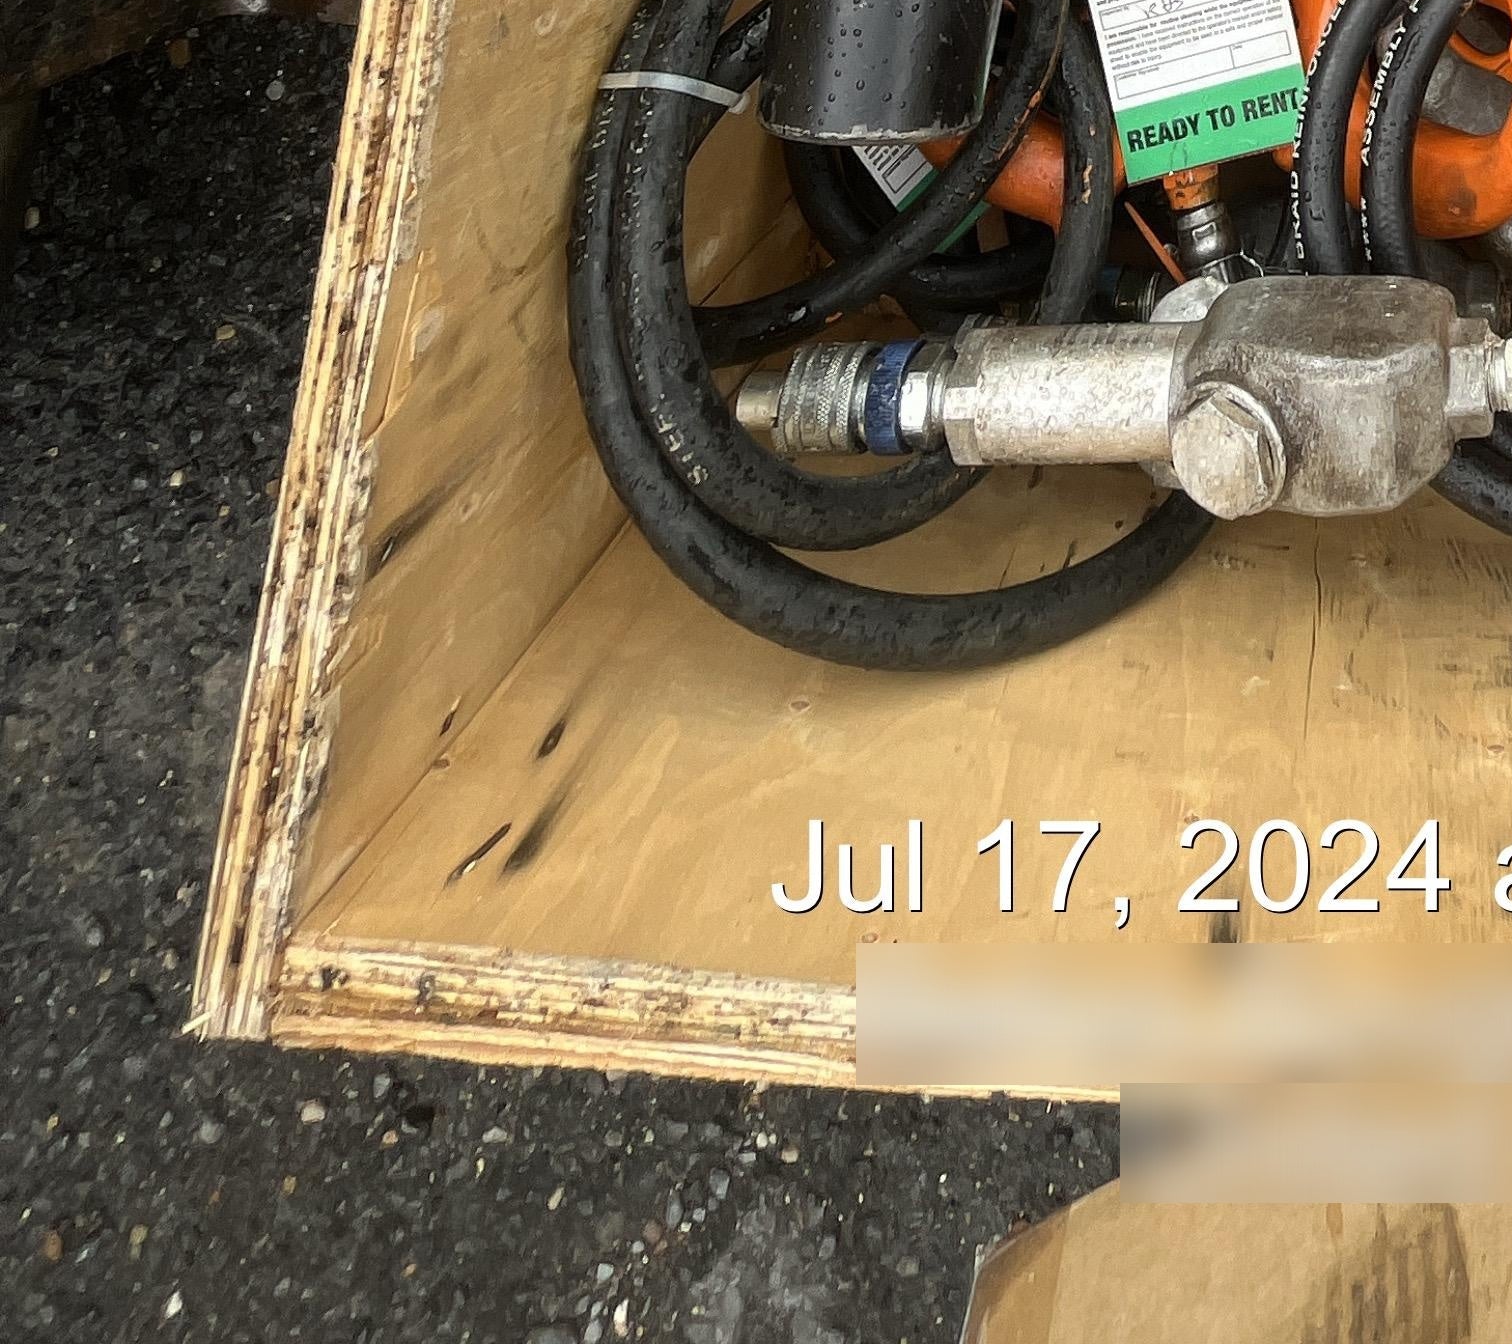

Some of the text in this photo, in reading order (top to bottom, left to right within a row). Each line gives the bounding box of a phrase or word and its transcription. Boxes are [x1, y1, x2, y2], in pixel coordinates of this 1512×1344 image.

[1126, 87, 1301, 153] READY TO RENT
[1360, 23, 1409, 167] ASSEMBLY
